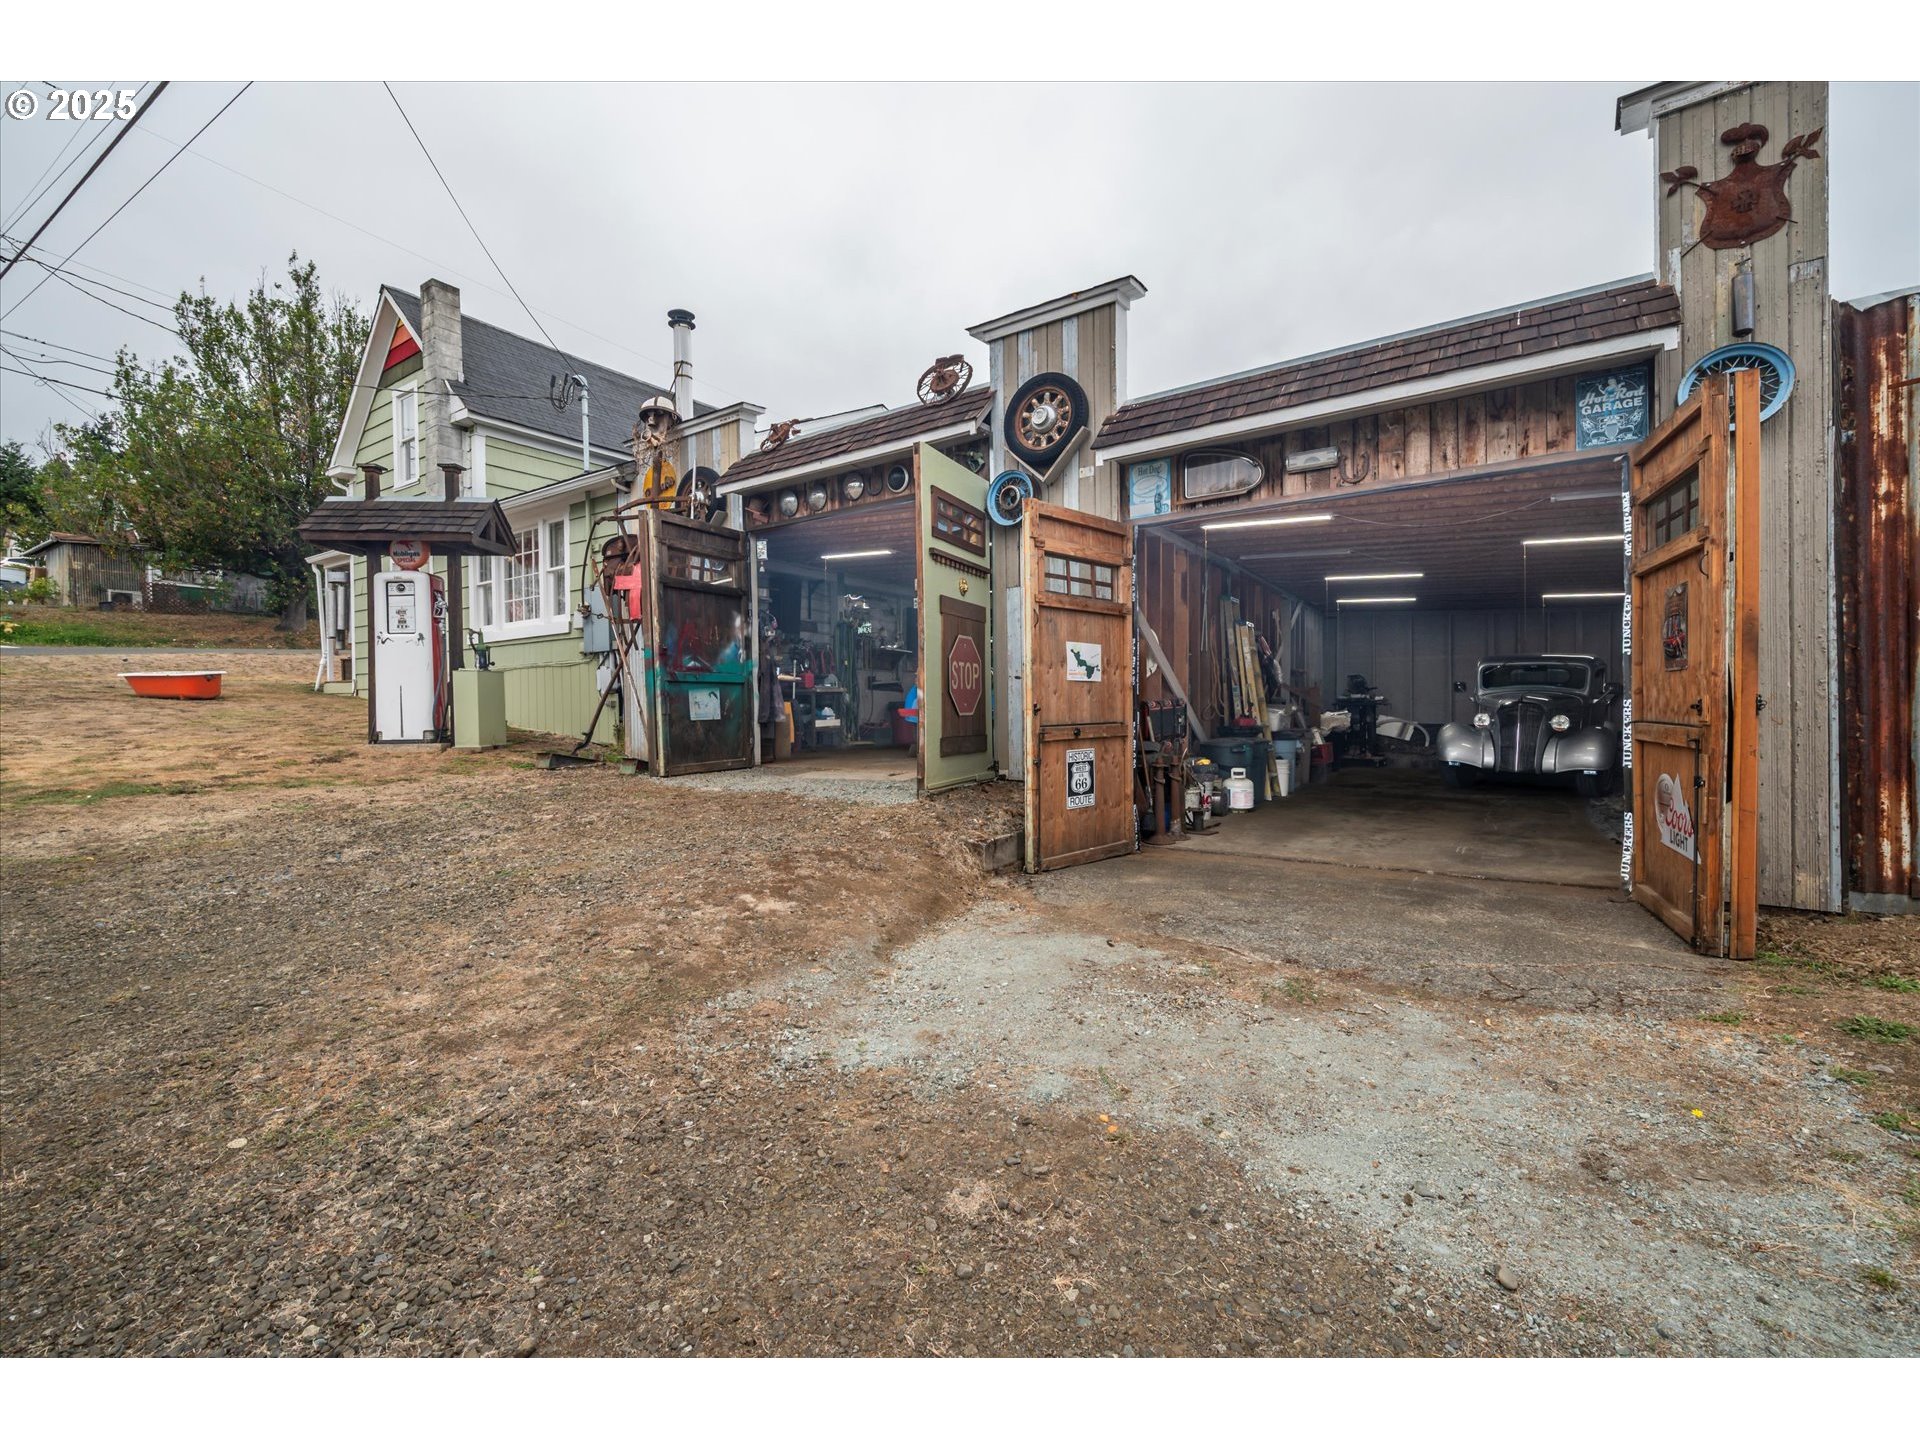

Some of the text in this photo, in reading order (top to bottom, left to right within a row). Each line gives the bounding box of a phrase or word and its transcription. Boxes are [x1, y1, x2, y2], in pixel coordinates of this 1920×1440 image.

[1616, 385, 1646, 399] Rod
[1581, 397, 1643, 415] GARAGE
[951, 661, 980, 690] STOP
[1622, 698, 1633, 769] JUNCKERS
[1068, 751, 1093, 762] HISTORIC
[1075, 777, 1088, 790] 66
[1069, 794, 1093, 806] ROUTE
[1665, 797, 1694, 838] Coors
[1620, 811, 1633, 881] JUNCKERS
[1669, 828, 1689, 852] LIGHT
